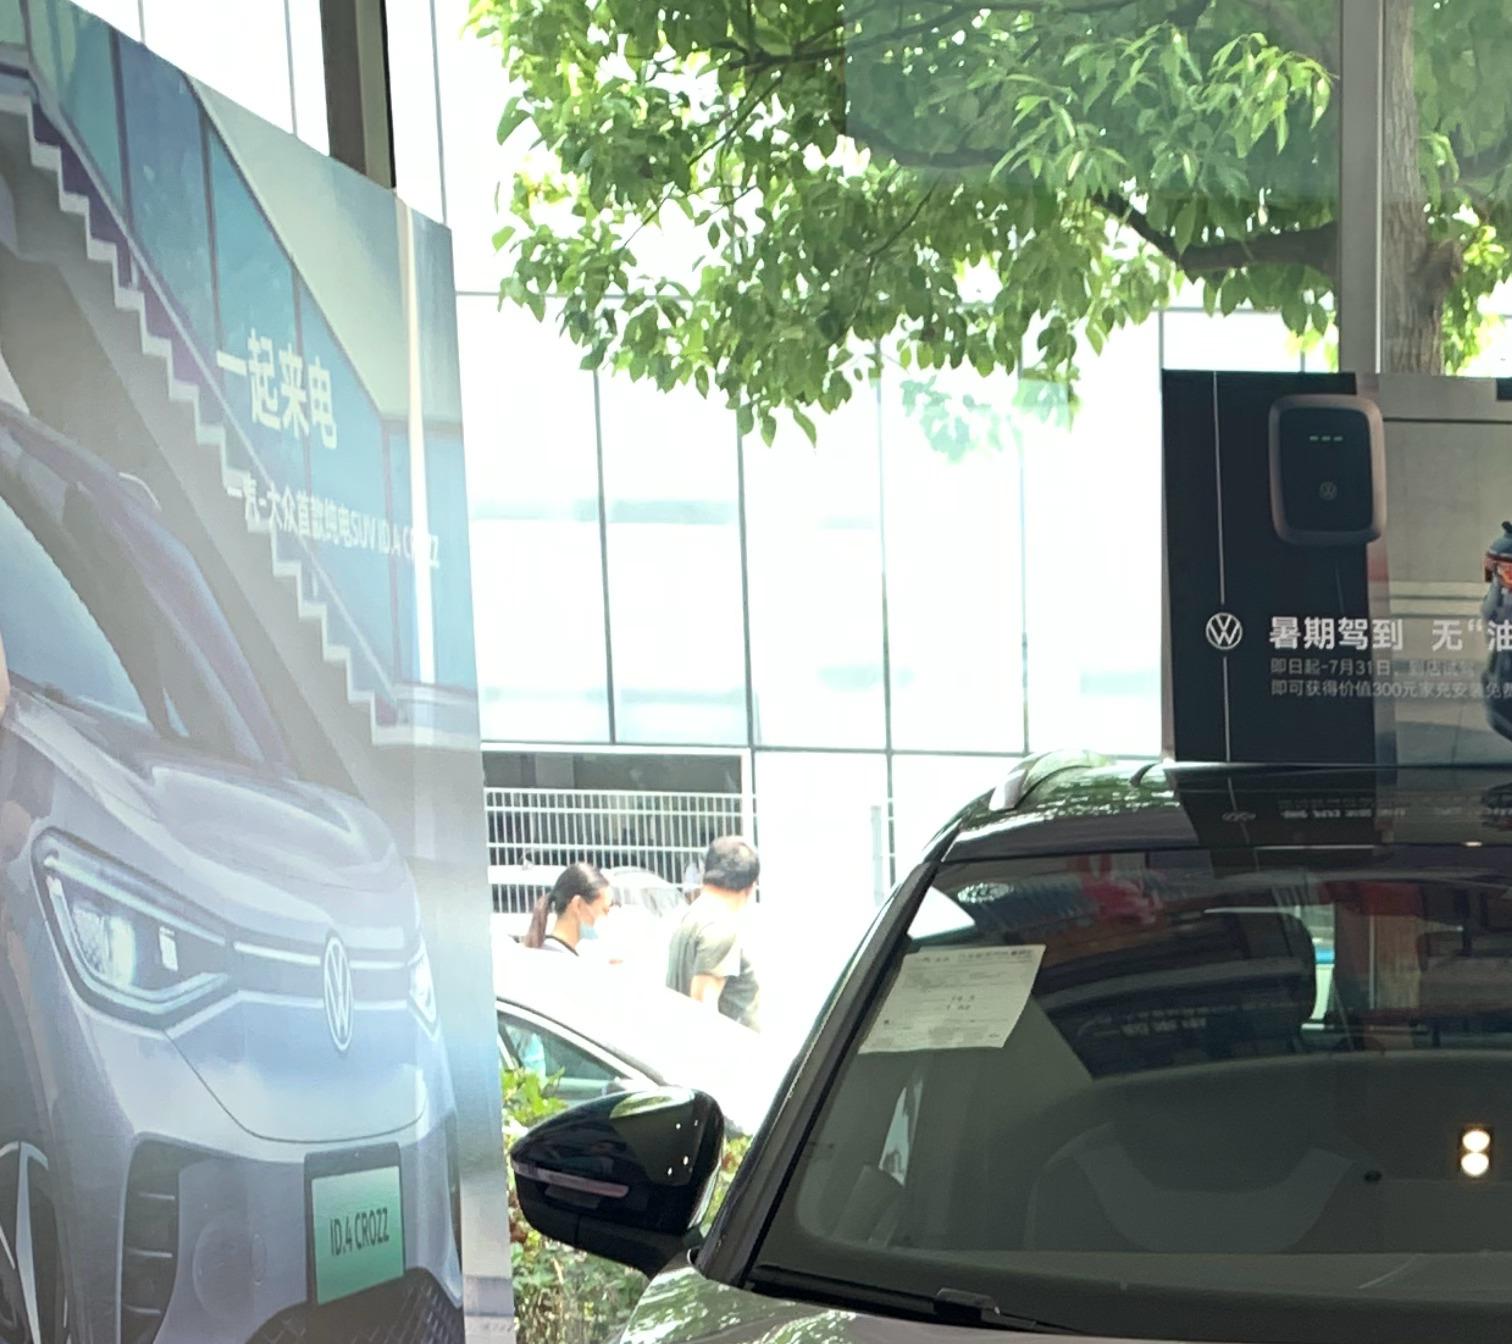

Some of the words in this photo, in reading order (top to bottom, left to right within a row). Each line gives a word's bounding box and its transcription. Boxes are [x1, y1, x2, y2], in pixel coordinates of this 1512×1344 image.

[216, 327, 338, 450] 一起来电
[1269, 616, 1403, 650] 暑期驾到
[330, 1216, 353, 1257] ID.4
[354, 1206, 390, 1250] CROZZ
